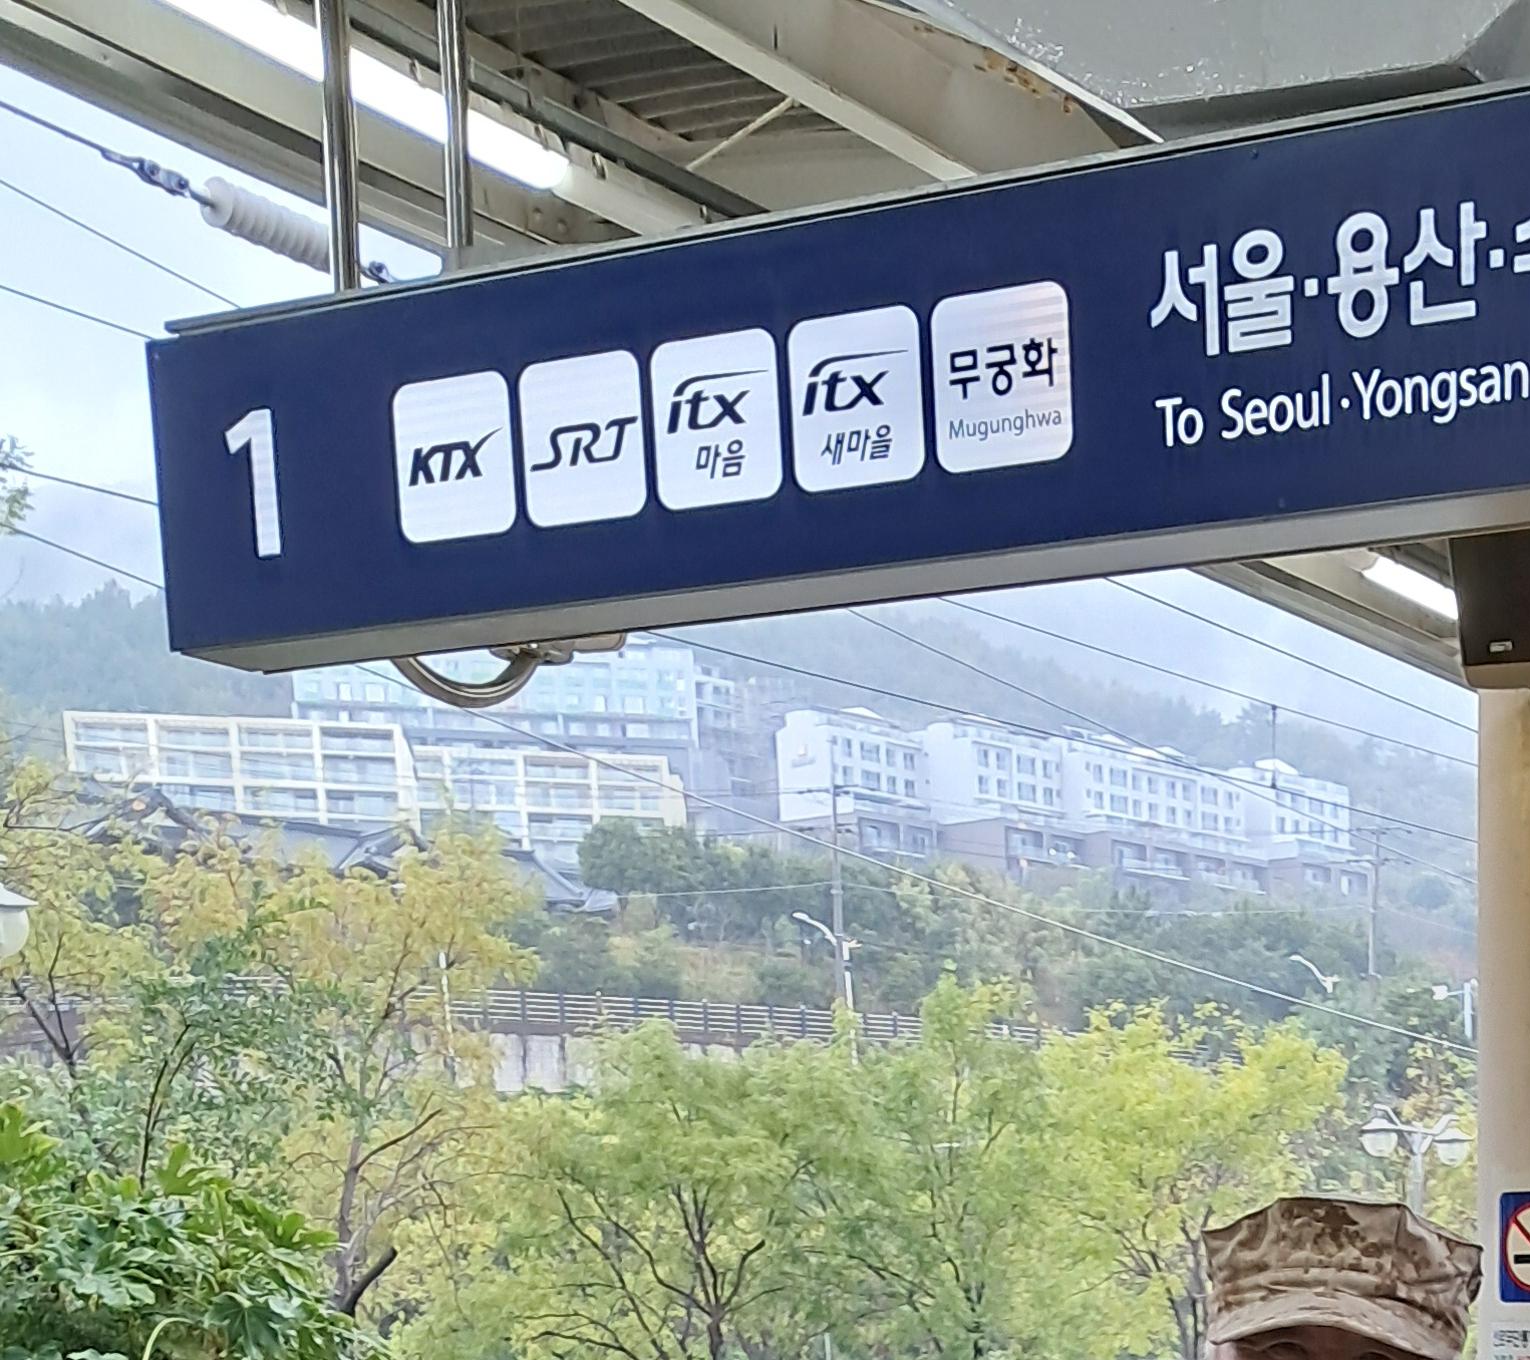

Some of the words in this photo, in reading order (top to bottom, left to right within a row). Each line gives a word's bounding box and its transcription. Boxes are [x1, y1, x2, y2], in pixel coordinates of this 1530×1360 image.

[948, 337, 1058, 399] 무궁화
[948, 408, 1062, 441] Mugunghwa
[1154, 396, 1205, 448] To
[1220, 372, 1331, 441] Seoul
[1350, 360, 1530, 425] Yongsan
[408, 427, 503, 487] KTX
[529, 415, 639, 473] SRT
[695, 439, 746, 479] 마음
[820, 424, 892, 465] 새마을
[224, 407, 282, 558] 1
